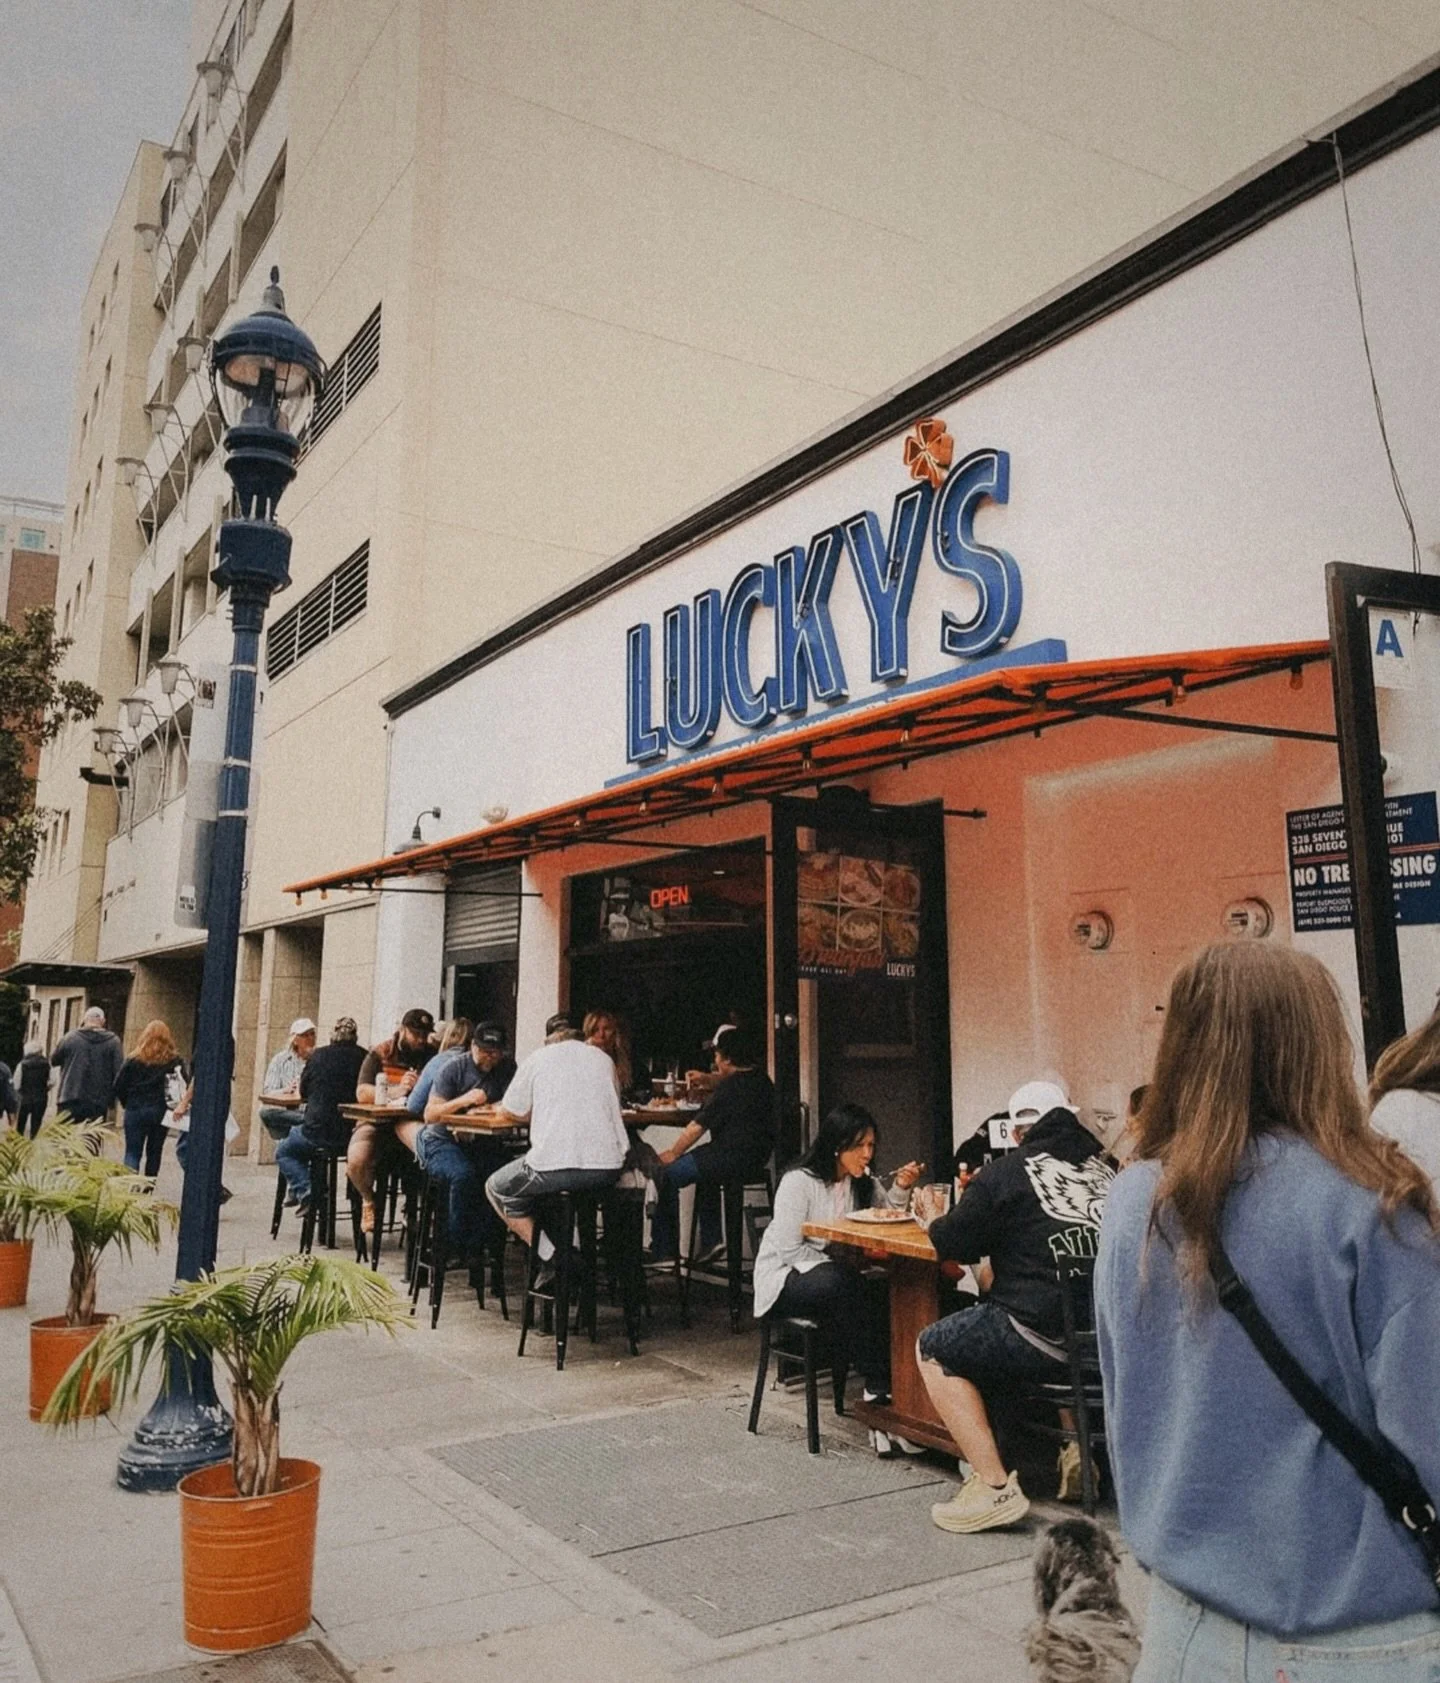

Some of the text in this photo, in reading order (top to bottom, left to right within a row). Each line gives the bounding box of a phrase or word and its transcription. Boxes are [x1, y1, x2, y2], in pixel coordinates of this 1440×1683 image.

[1375, 619, 1404, 657] A
[1321, 809, 1345, 818] AGENC
[1303, 821, 1317, 829] SAN
[1318, 818, 1341, 827] DIEGO
[1312, 829, 1346, 843] SEVEN
[1292, 840, 1348, 855] SAN DIEGO
[1294, 866, 1318, 887] NO
[650, 884, 689, 909] OPEN
[886, 962, 916, 977] LUCKYS
[999, 1121, 1008, 1139] 6
